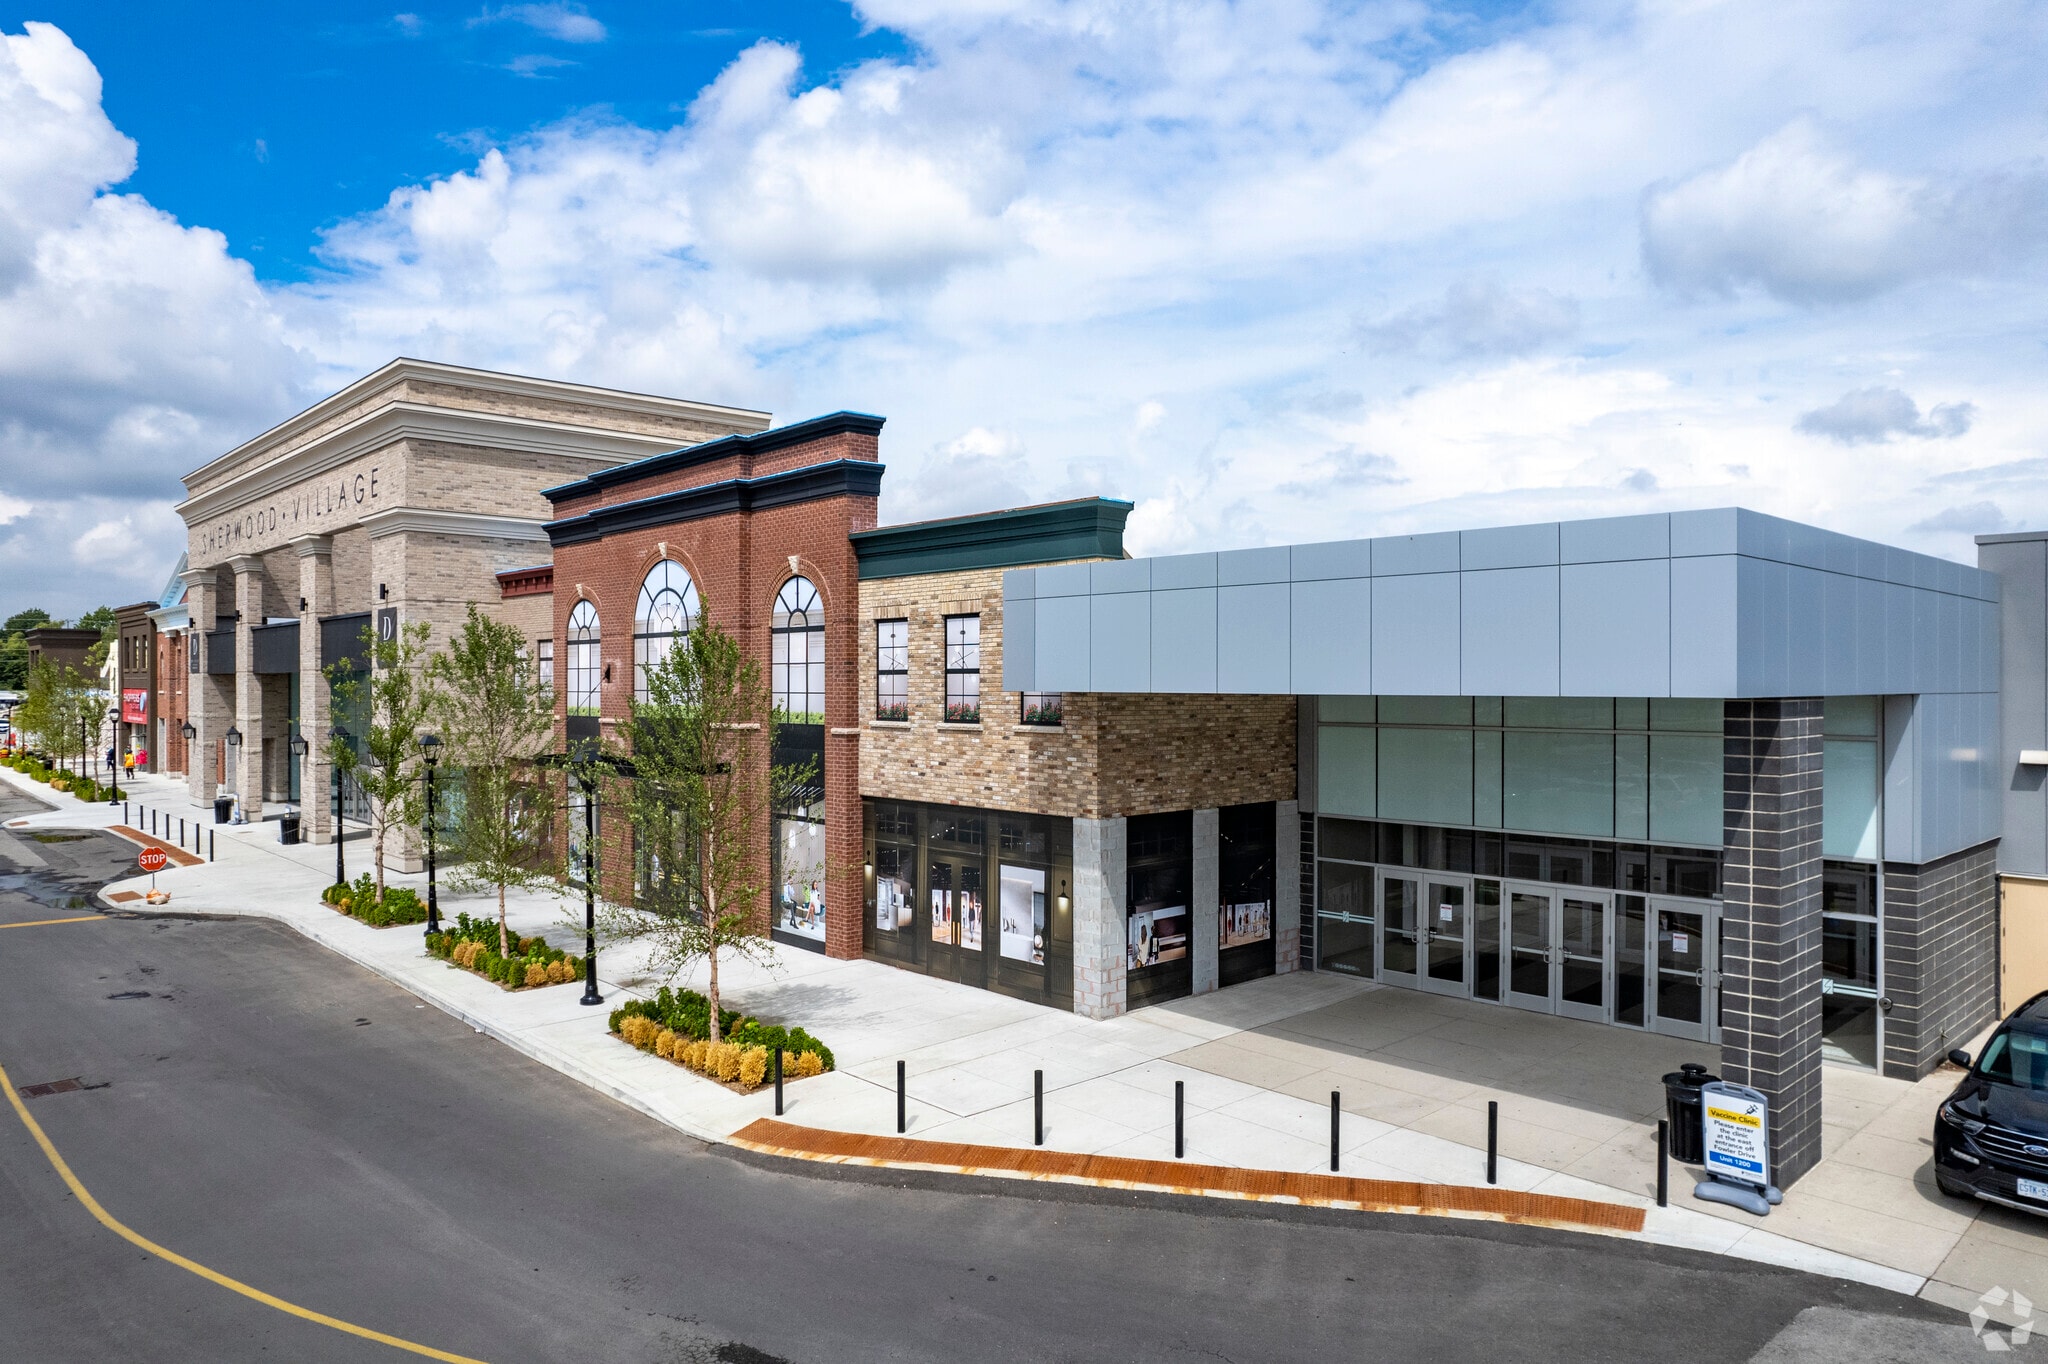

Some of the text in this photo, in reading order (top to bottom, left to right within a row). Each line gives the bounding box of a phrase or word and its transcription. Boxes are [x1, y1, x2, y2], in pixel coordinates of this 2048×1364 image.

[202, 467, 379, 555] SHERWOOD VILLAGE
[383, 616, 392, 641] D
[140, 853, 166, 865] STOP
[1711, 1110, 1758, 1126] Vaccine Clinic
[1714, 1120, 1734, 1129] Please
[1714, 1144, 1755, 1159] Fowler Drive
[1715, 1140, 1742, 1149] entrance
[1720, 1155, 1732, 1163] Unit
[1735, 1159, 1751, 1168] 1200
